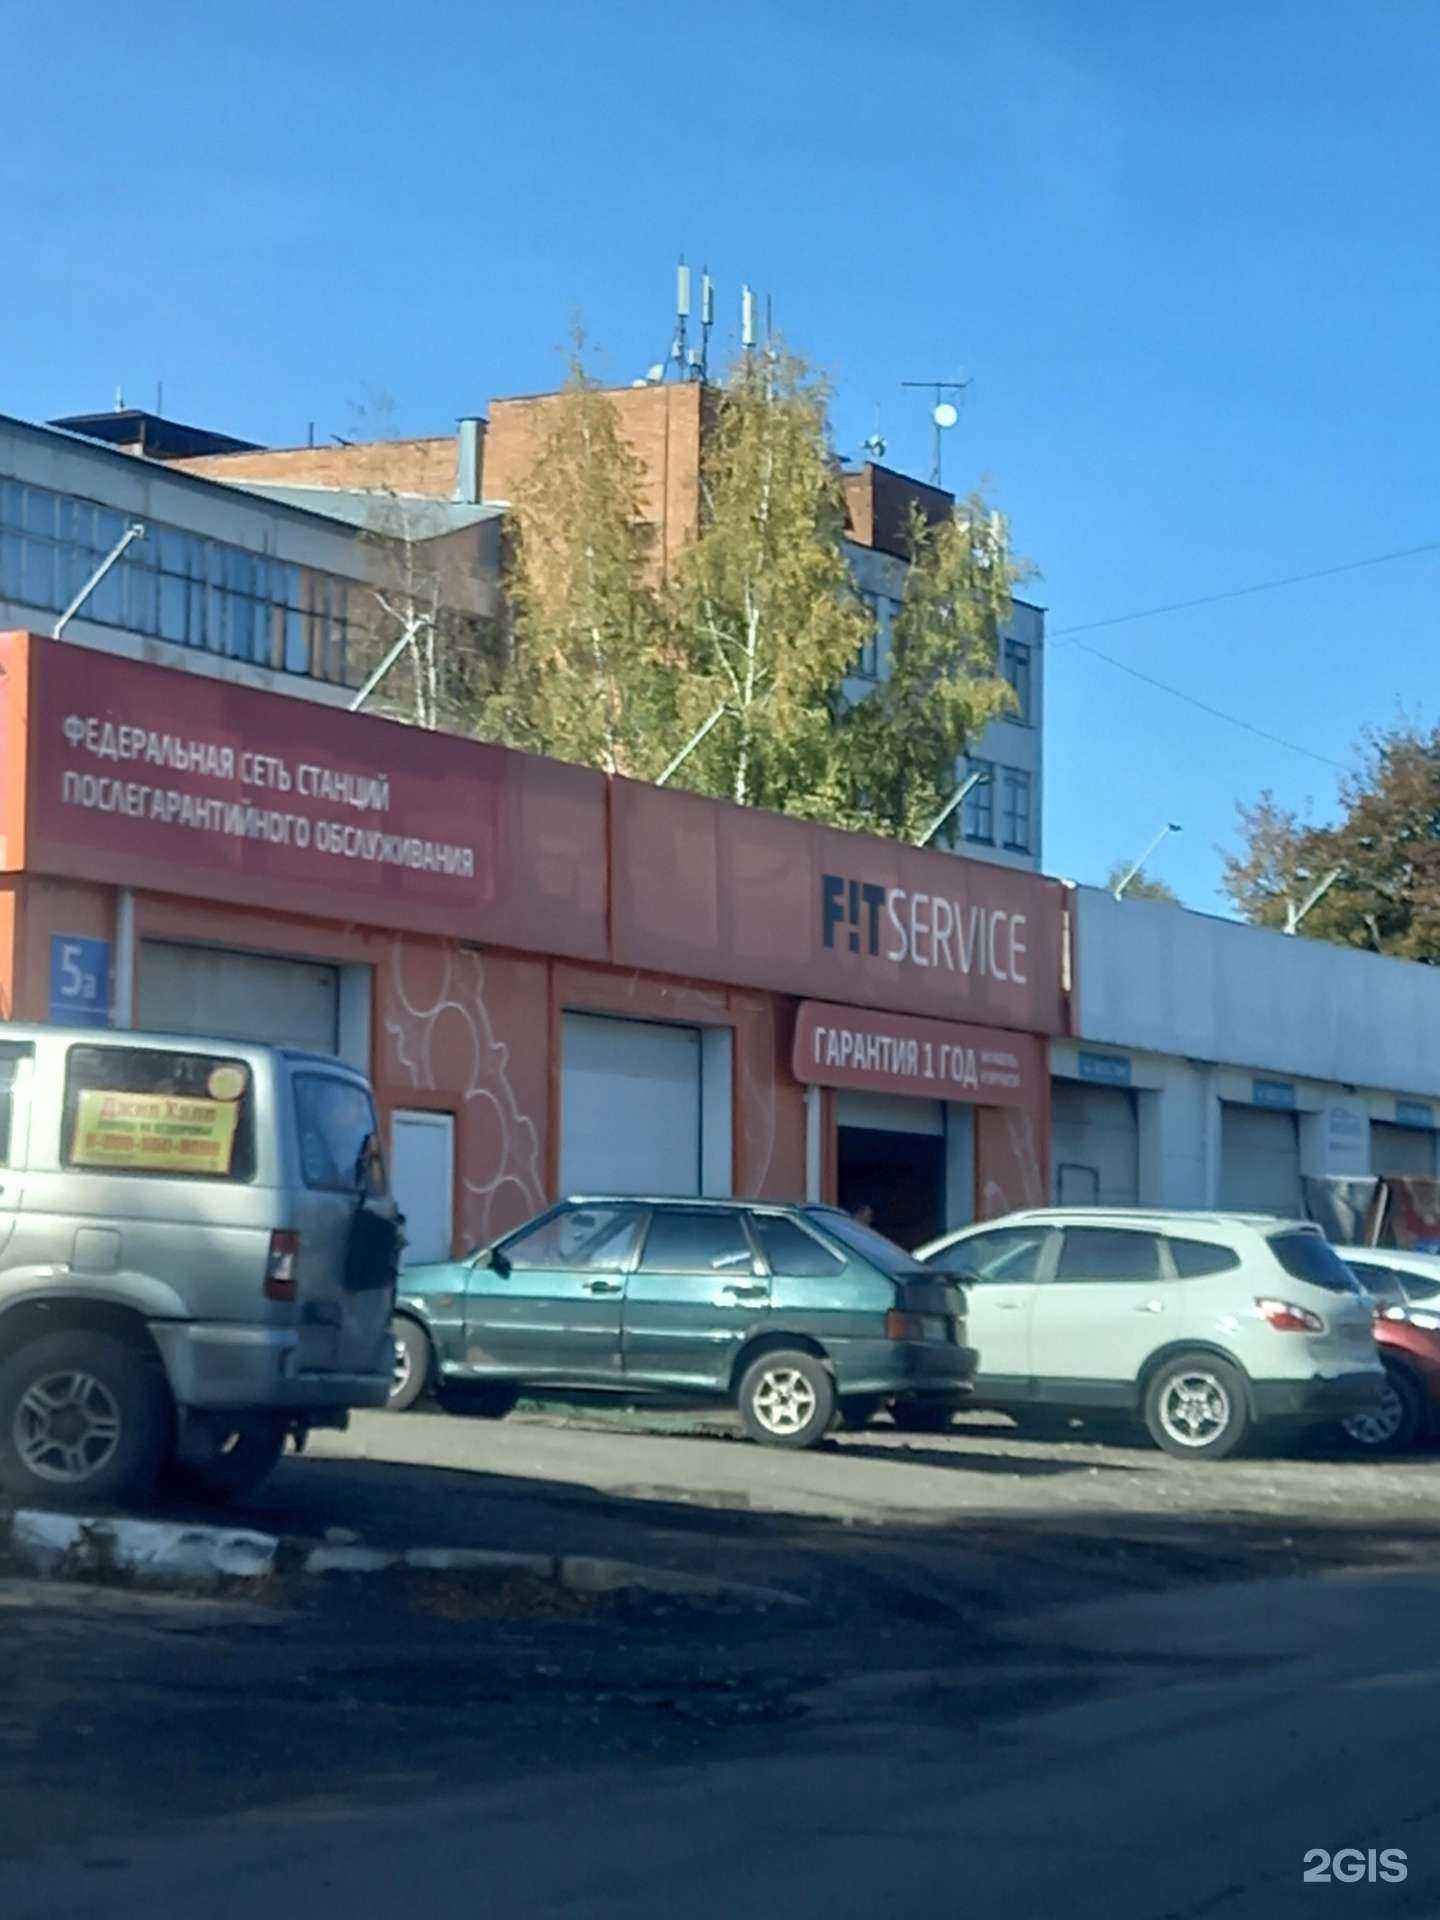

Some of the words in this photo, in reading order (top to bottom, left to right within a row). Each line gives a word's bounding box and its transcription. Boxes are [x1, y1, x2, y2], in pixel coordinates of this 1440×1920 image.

[62, 715, 234, 780] ФЕДЕРАЛЬНАЯ
[241, 752, 292, 792] СЕТЬ
[299, 764, 390, 811] СТАНЦИЙ
[62, 771, 311, 848] ПОСЛЕГАРАНТИЙНОГО
[315, 822, 475, 878] ОБСЛУЖИВАНИЯ
[814, 1026, 919, 1077] ГАРАНТИЯ
[923, 1043, 935, 1079] 1
[940, 1045, 979, 1090] ГОД
